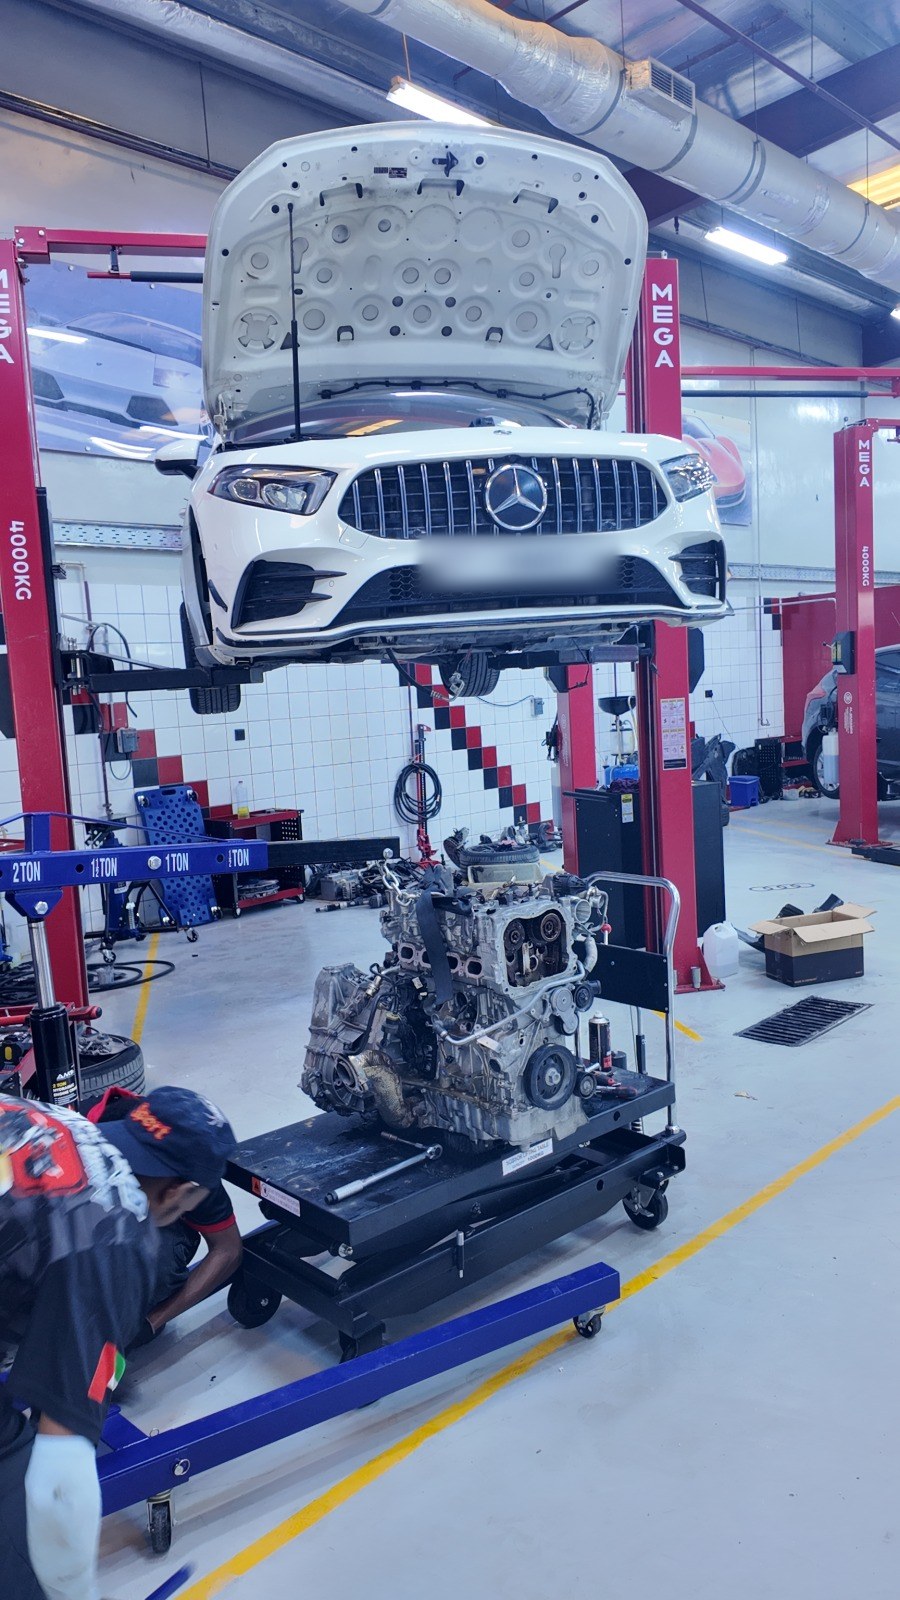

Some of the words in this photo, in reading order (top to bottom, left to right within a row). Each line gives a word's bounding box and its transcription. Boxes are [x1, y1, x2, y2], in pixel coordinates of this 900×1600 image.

[651, 283, 674, 368] MEGA
[858, 439, 870, 487] MEGA
[9, 520, 32, 601] 4000KG
[861, 545, 870, 587] 4000KG
